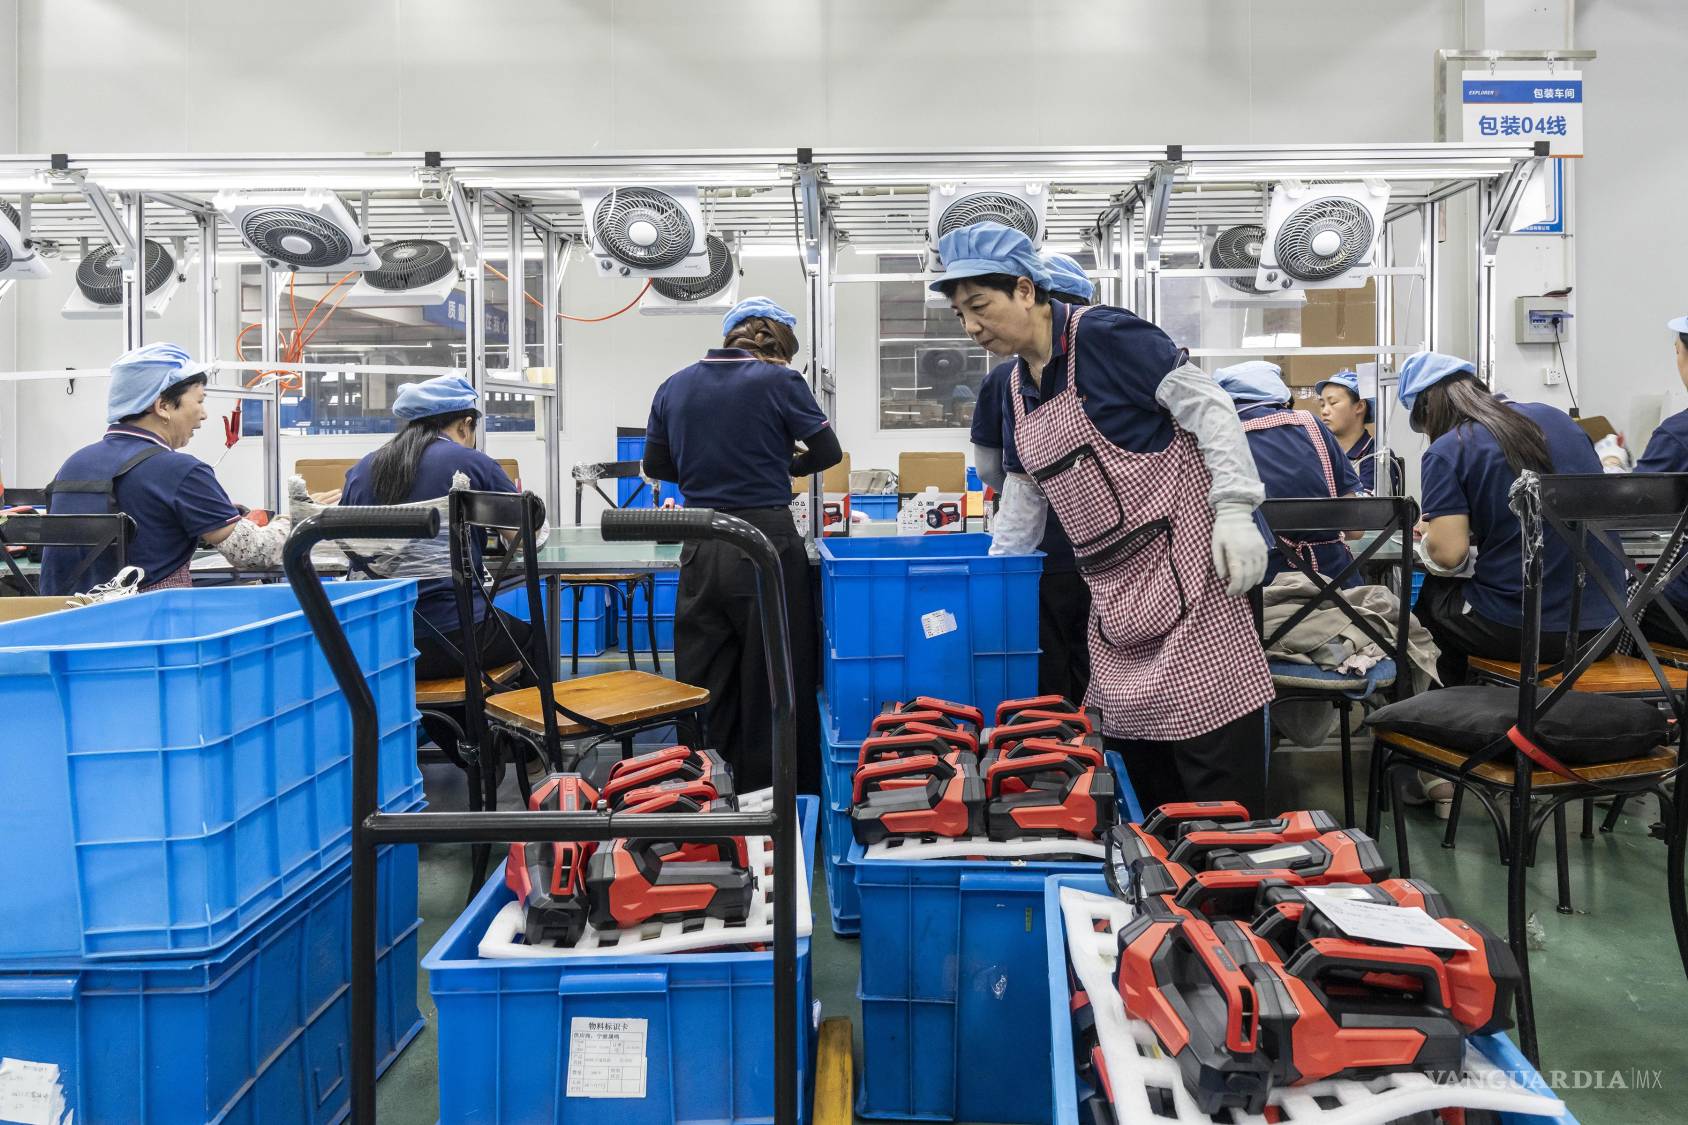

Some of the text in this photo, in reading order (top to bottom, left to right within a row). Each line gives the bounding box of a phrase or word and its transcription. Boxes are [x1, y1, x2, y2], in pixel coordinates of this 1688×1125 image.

[1533, 88, 1575, 99] 包装车间
[1478, 115, 1567, 136] 包装04线
[588, 1022, 629, 1031] 物料标识卡
